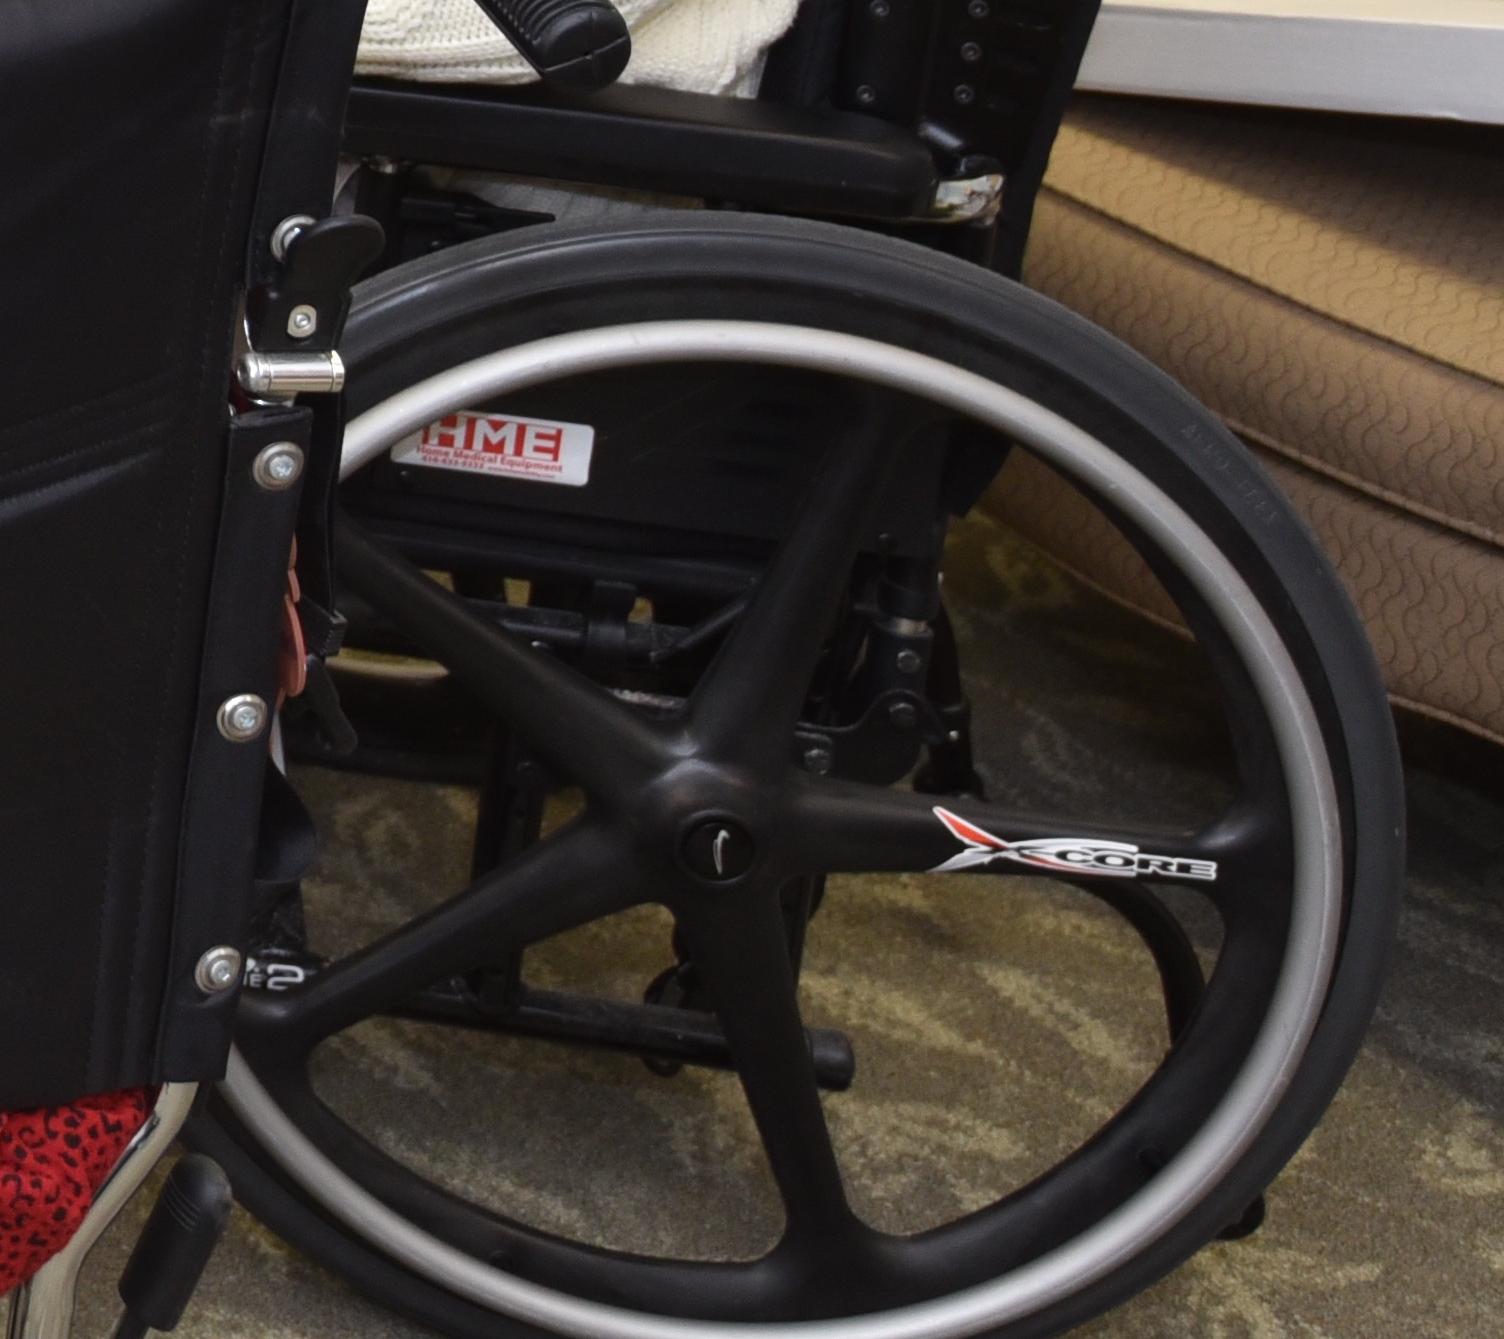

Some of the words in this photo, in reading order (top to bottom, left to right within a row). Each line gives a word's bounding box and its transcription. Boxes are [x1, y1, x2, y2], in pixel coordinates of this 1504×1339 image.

[426, 413, 561, 462] HME
[416, 444, 450, 458] Home
[453, 448, 498, 465] Medical
[500, 454, 563, 473] Equipment
